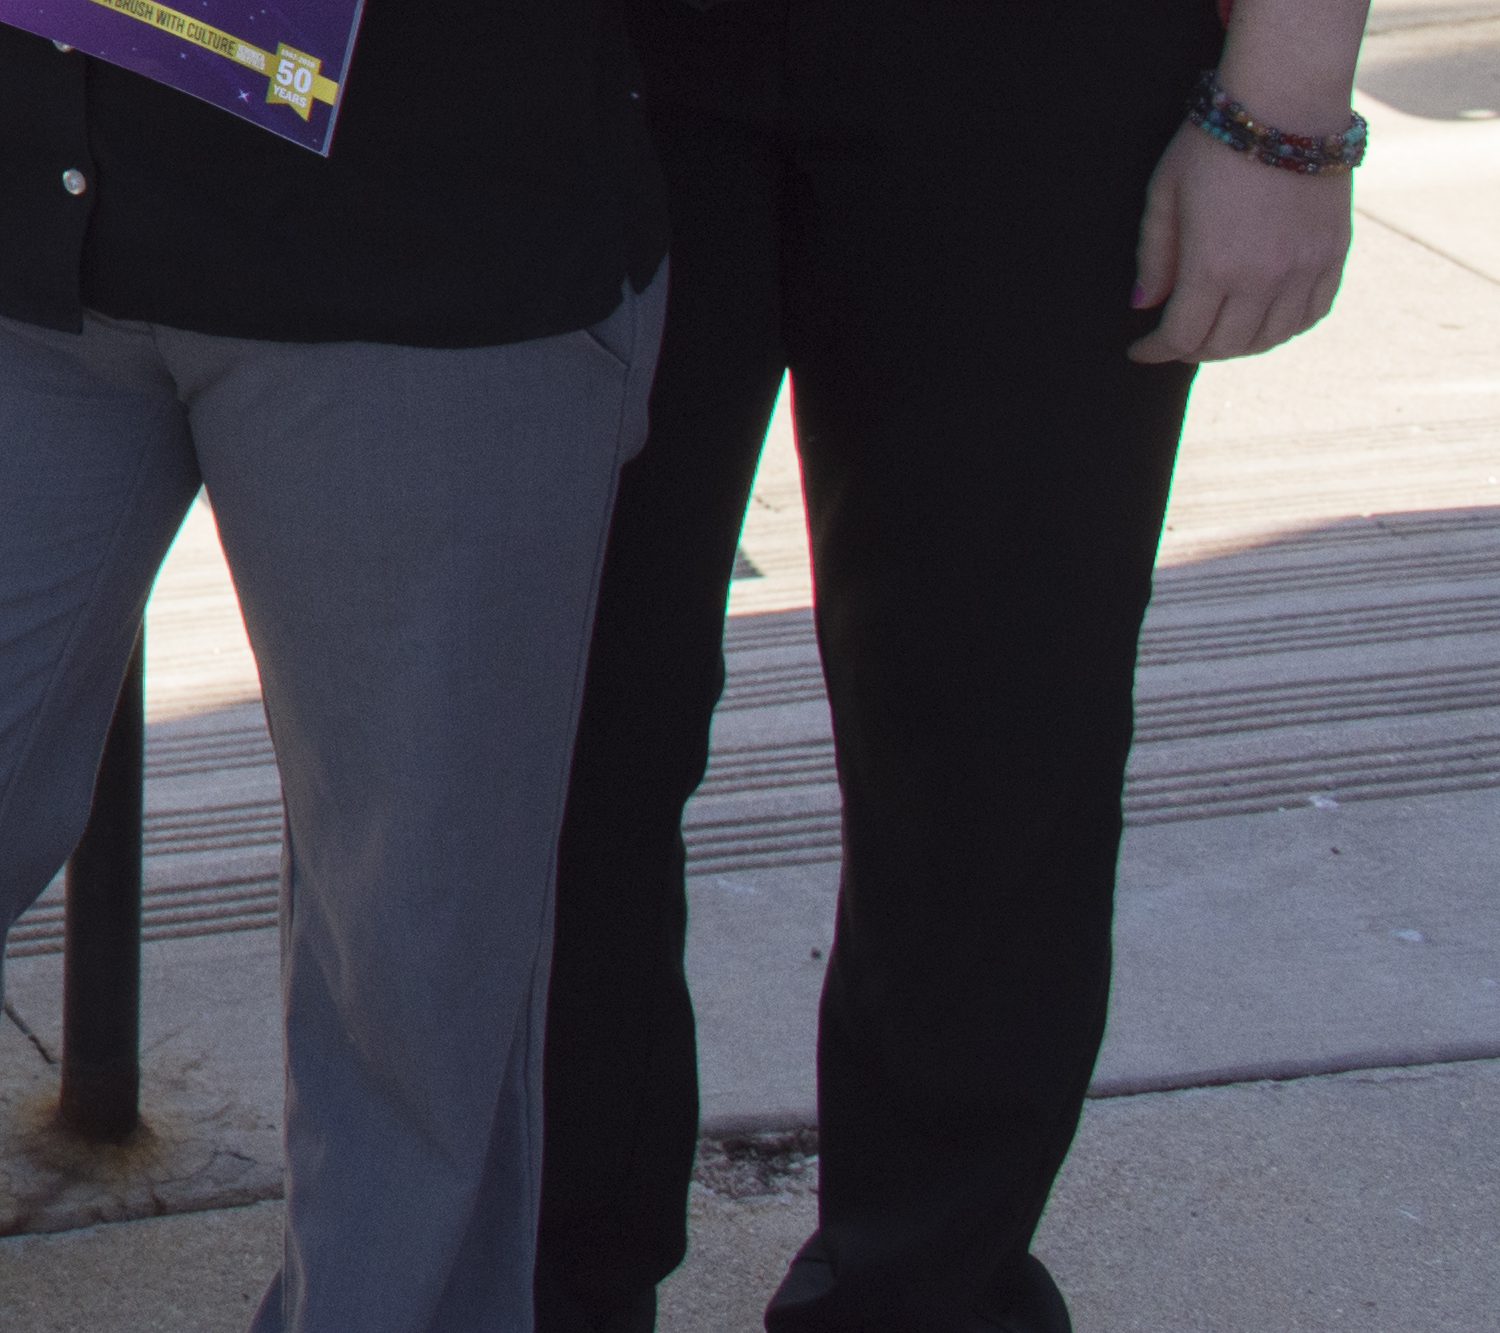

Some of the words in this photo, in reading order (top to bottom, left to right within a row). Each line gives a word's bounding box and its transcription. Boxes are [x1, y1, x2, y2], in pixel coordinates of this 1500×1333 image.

[156, 9, 185, 32] WITH
[187, 23, 237, 57] CULTURE
[276, 59, 312, 94] 50
[273, 84, 306, 108] YEARS
